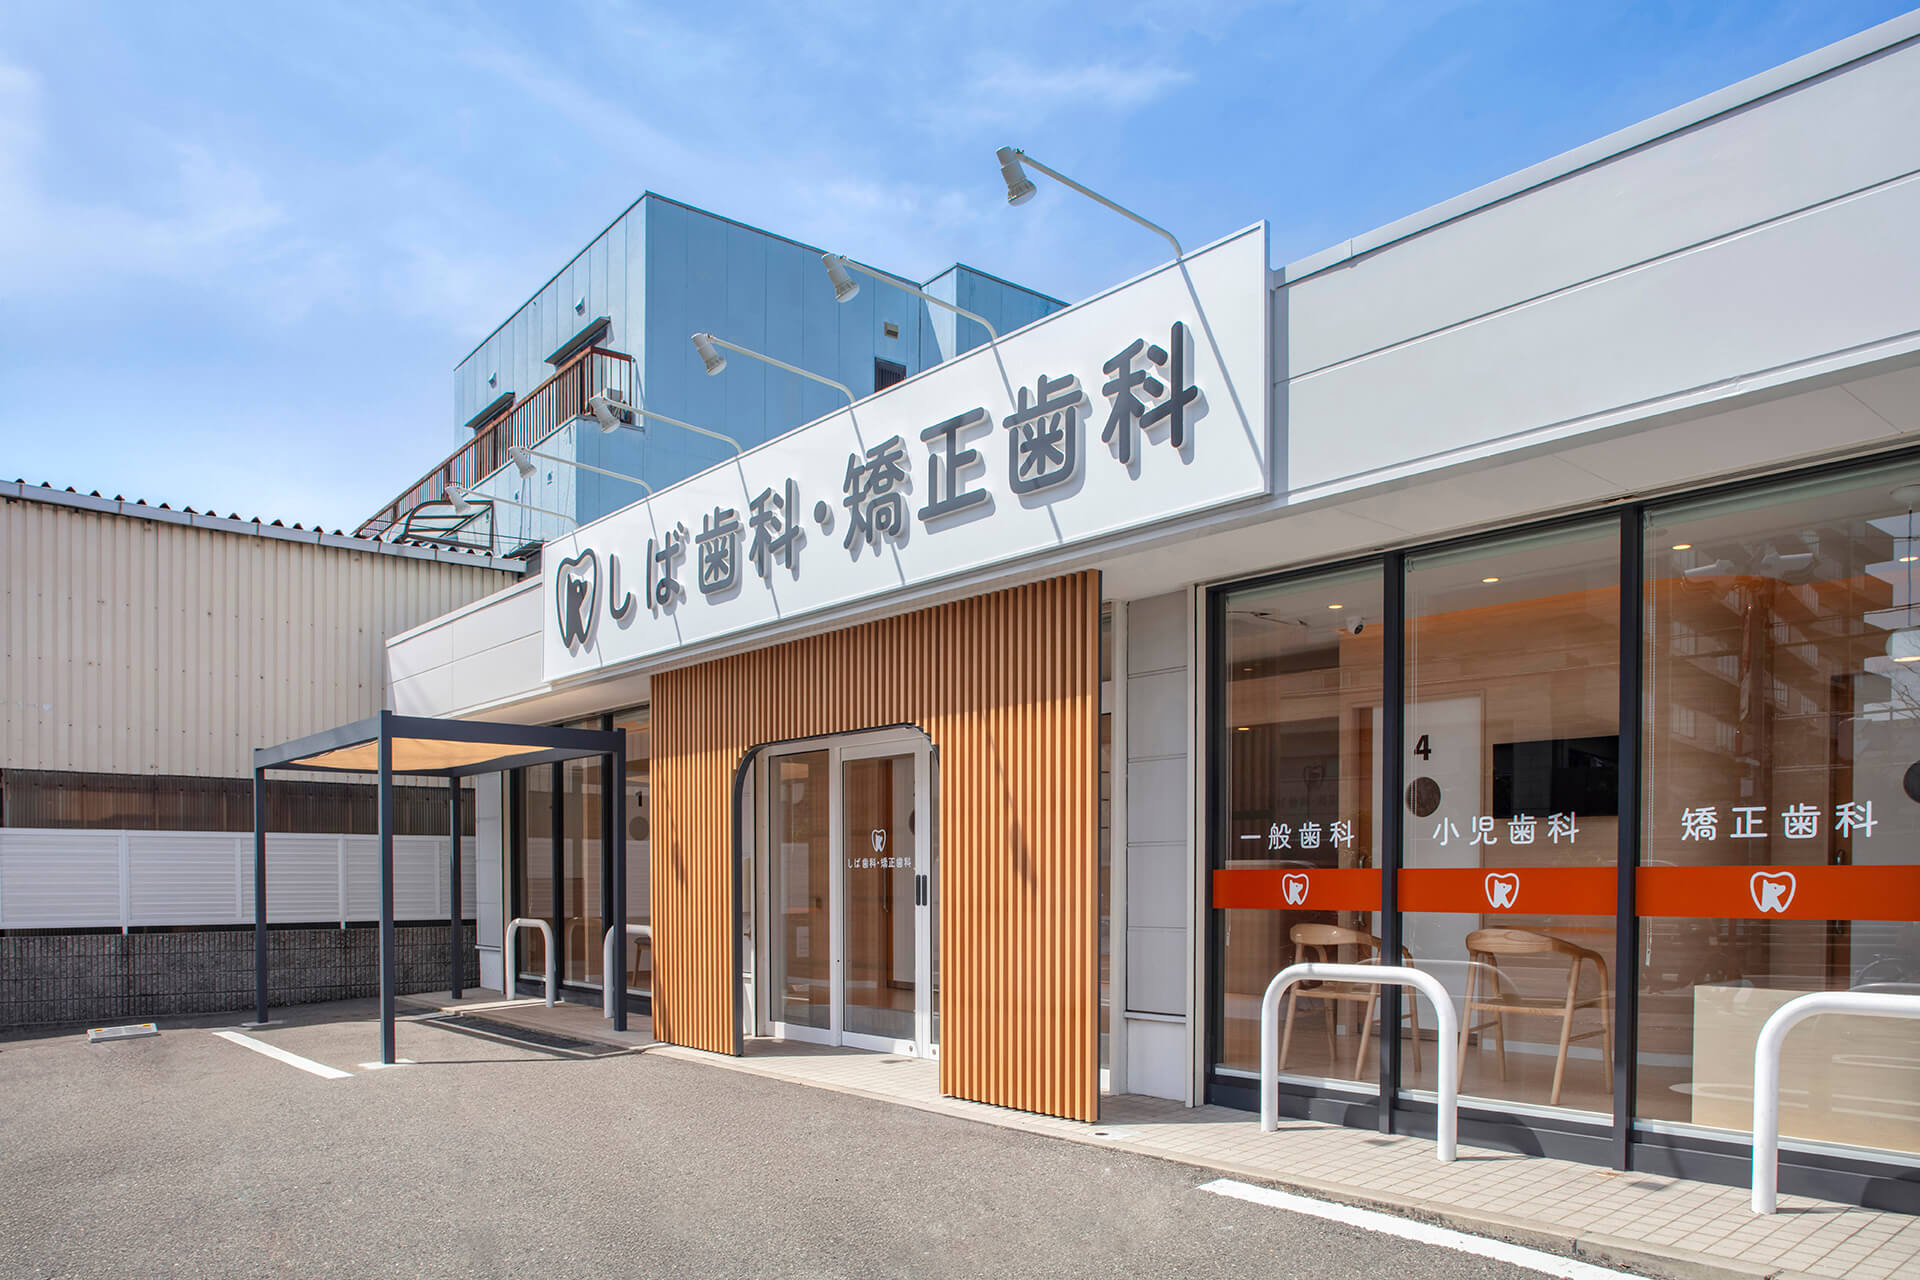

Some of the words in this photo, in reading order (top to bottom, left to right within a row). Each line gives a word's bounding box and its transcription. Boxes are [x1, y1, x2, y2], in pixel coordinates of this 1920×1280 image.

[609, 321, 1199, 621] しば歯科・矯正歯科
[1414, 735, 1431, 760] 4
[635, 791, 642, 807] 1
[1240, 820, 1355, 850] 一般歯科
[1432, 811, 1580, 846] 小児歯科
[1681, 800, 1878, 841] 矯正歯科
